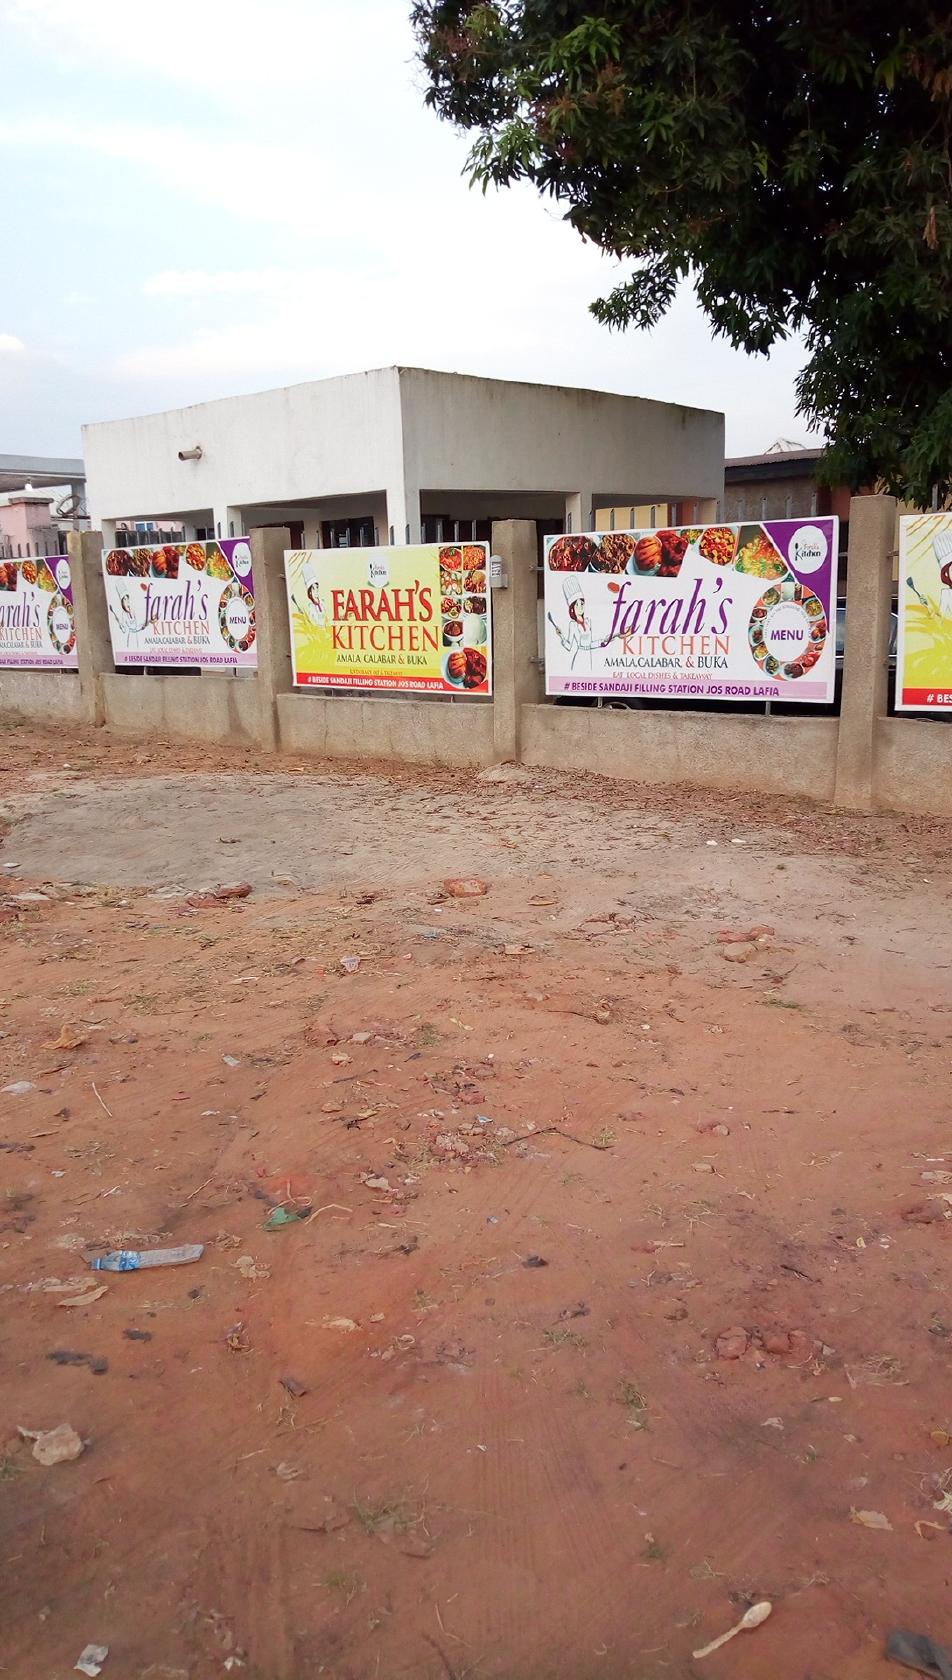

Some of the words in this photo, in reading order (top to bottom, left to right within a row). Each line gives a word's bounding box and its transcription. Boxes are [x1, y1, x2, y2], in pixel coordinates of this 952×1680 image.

[141, 579, 209, 631] farah's
[330, 579, 434, 622] FARAH'S
[0, 591, 41, 628] arah's
[600, 577, 733, 648] farah's
[152, 620, 210, 635] KITCHEN
[229, 616, 247, 624] MENU
[331, 625, 440, 652] KITCHEN
[770, 629, 804, 641] MENU
[622, 635, 731, 656] KITCHEN
[363, 654, 397, 665] CALABAR
[397, 654, 405, 665] &
[406, 655, 428, 665] BUKA
[685, 655, 695, 669] &
[697, 655, 729, 669] BUKA
[373, 679, 397, 688] STATION
[564, 682, 570, 691] #
[571, 682, 597, 691] BESIDE
[598, 682, 633, 692] SANDAJI
[634, 683, 666, 693] FILLING
[668, 684, 704, 694] STATION
[706, 685, 723, 695] JOS
[724, 686, 751, 696] ROAD
[753, 686, 780, 697] LAFIA
[936, 693, 952, 704] BES
